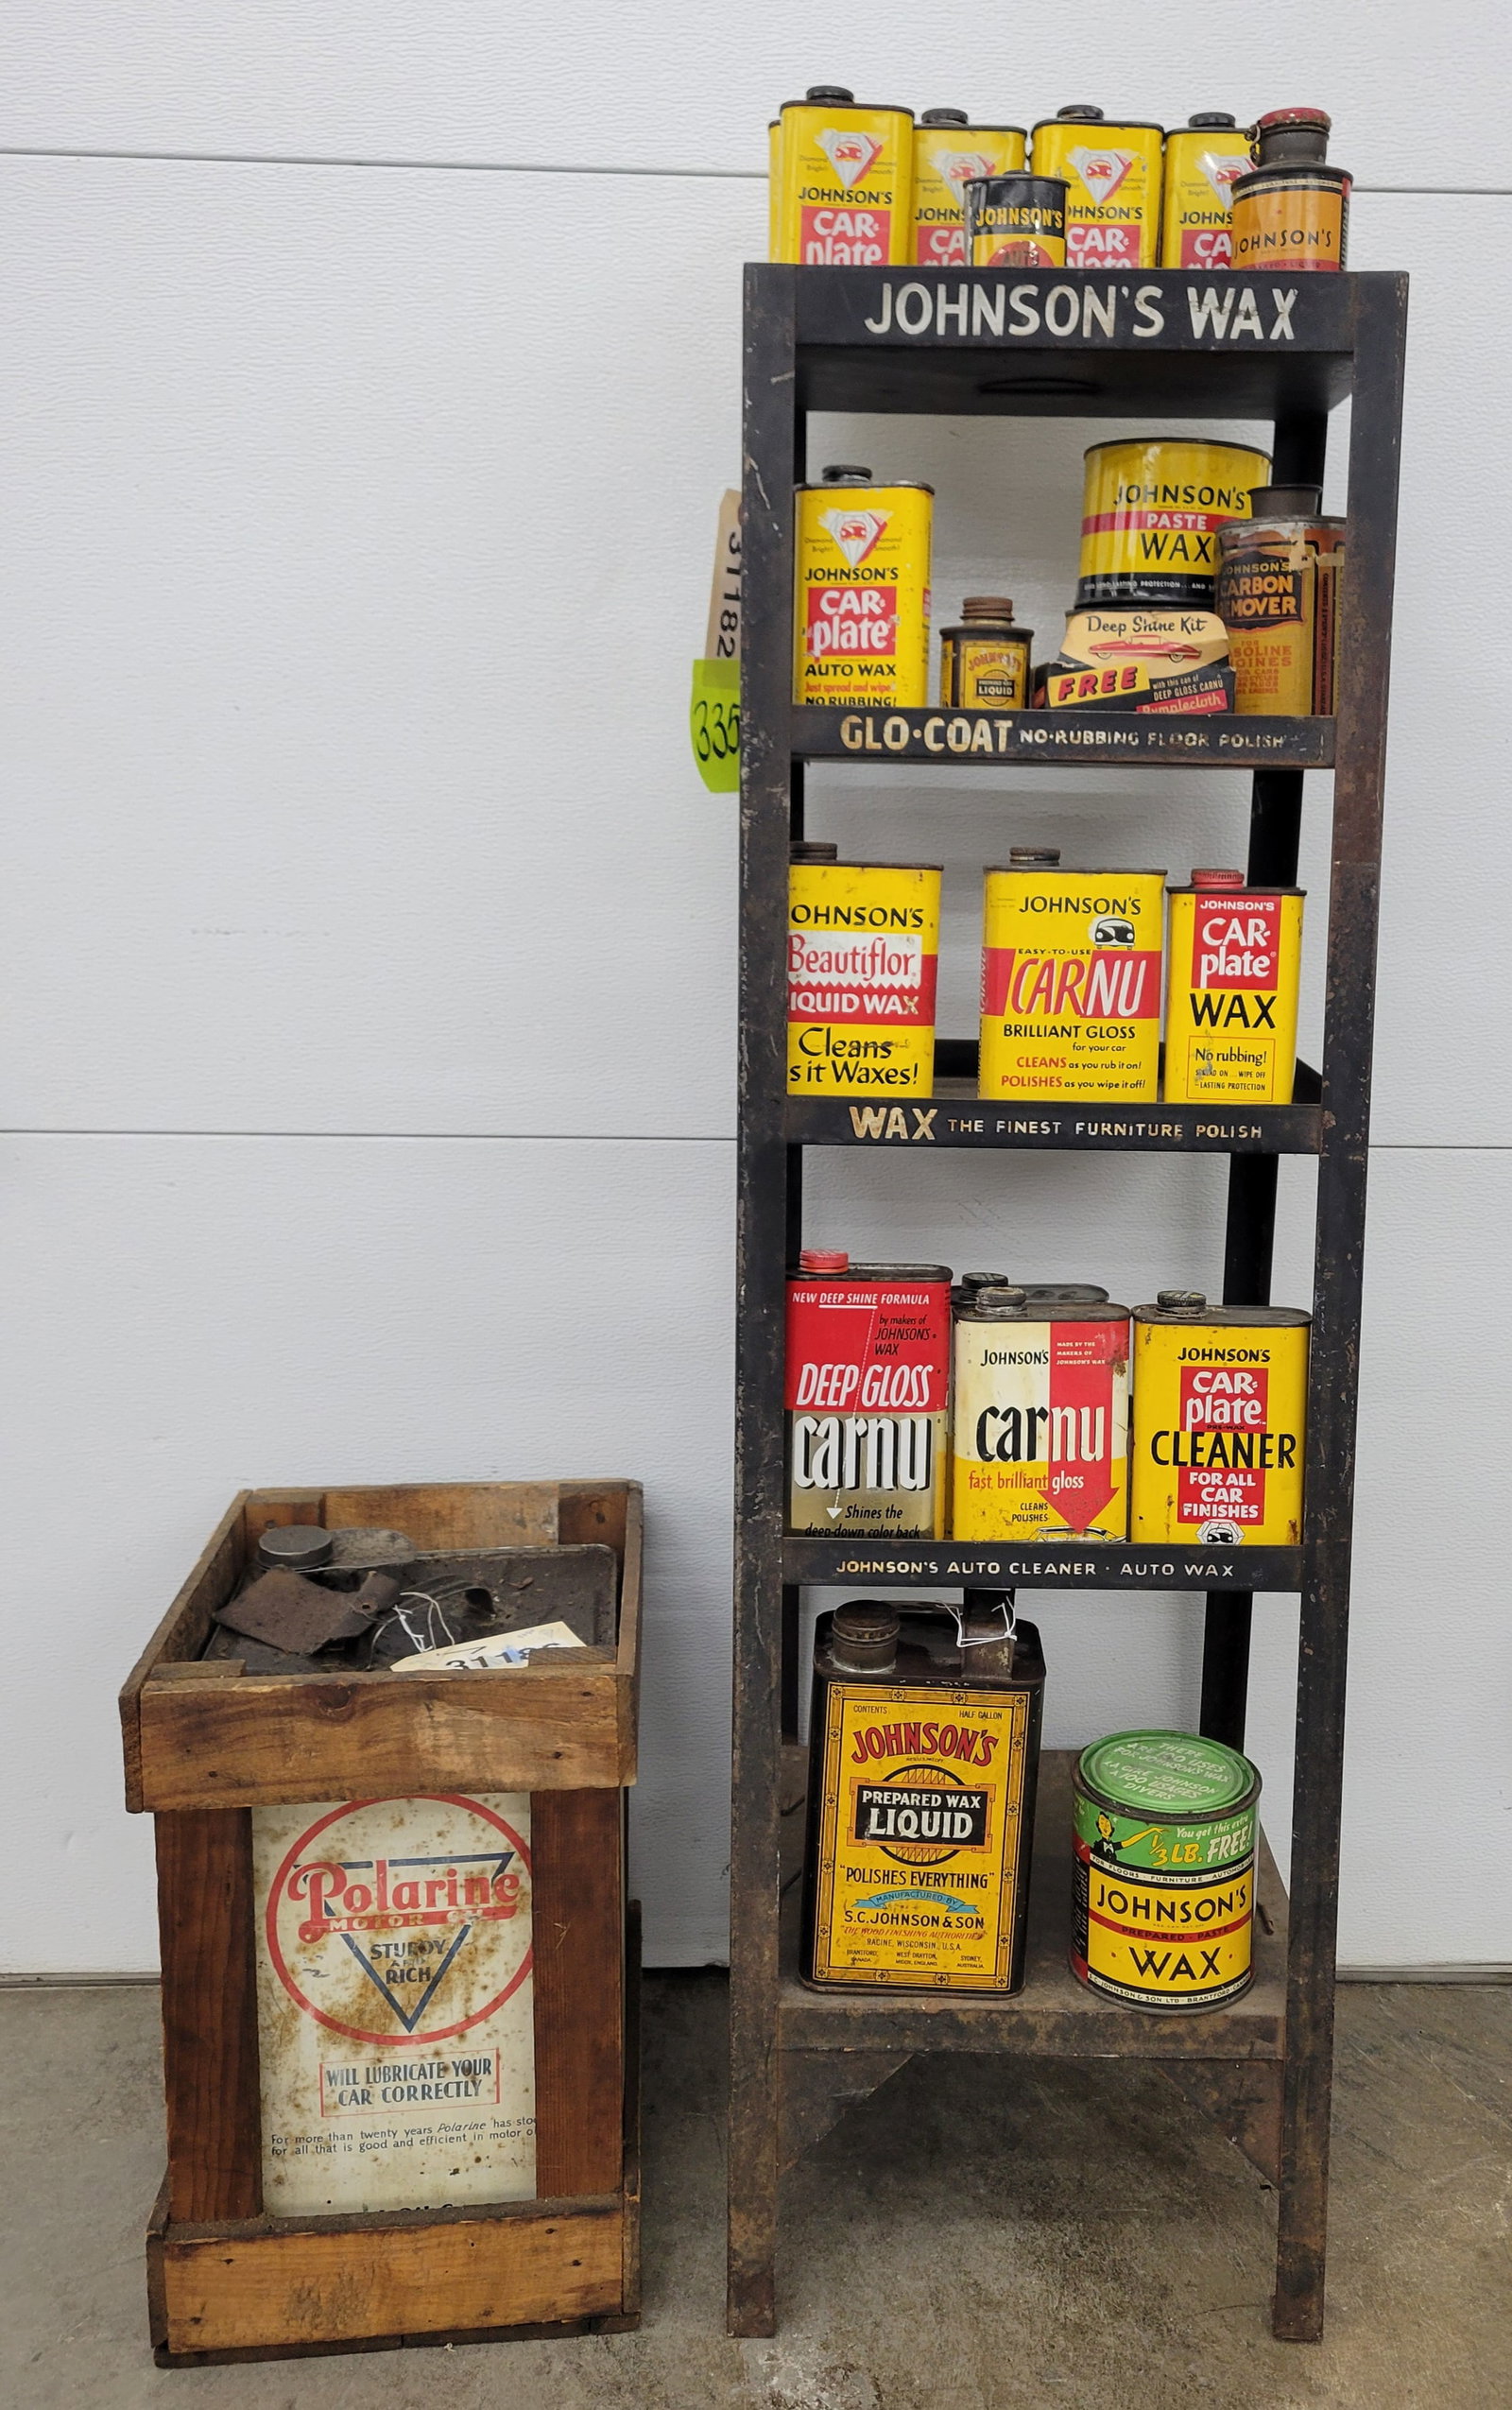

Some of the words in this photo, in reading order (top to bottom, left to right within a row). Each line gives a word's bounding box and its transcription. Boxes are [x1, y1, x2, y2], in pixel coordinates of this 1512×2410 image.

[799, 187, 892, 204] JOHNSON'S
[976, 208, 1063, 229] JOHNSON'S
[1069, 206, 1143, 219] HNSON'S
[1179, 212, 1232, 224] JOHNS
[1234, 229, 1331, 259] JOHNSON'S
[864, 284, 1163, 339] JOHNSON'S
[1188, 286, 1297, 341] WAX
[1113, 485, 1246, 510] JOHNSON'S
[1147, 513, 1208, 530] PASTE
[1141, 533, 1211, 563] WAX
[805, 567, 899, 581] JOHNSON'S
[815, 616, 889, 656] plate
[1088, 616, 1127, 637] Deep
[1181, 616, 1208, 635] Kit
[805, 664, 853, 676] AUTO
[858, 664, 896, 676] WAX
[979, 686, 1012, 695] LIQUID
[1058, 666, 1137, 701] FREE
[1154, 689, 1172, 701] DEEP
[1175, 684, 1197, 697] GLOSS
[829, 697, 897, 707] RUBBING!
[1147, 732, 1210, 749] FLOOR
[1019, 896, 1141, 915] JOHNSON'S
[1200, 901, 1275, 911] JOHNSON'S
[791, 904, 923, 927] OHNSON'S
[788, 934, 917, 980] Beautiflor
[1201, 946, 1270, 989] plate
[1011, 957, 1146, 1016] CARNU
[789, 991, 860, 1013] IQUID
[864, 995, 919, 1014] WAX
[1190, 993, 1277, 1029] WAX
[1004, 1024, 1081, 1038] BRILLIANT
[1086, 1026, 1135, 1038] GLOSS
[799, 1027, 892, 1059] Cleans
[1073, 1042, 1086, 1051] for
[1089, 1044, 1109, 1053] your
[1017, 1057, 1067, 1068] CLEANS
[1082, 1061, 1099, 1070] you
[1101, 1059, 1116, 1069] rub
[1119, 1060, 1125, 1069] it
[1195, 1048, 1213, 1060] No
[1217, 1046, 1266, 1066] rubbing!
[807, 1061, 826, 1082] it
[832, 1060, 918, 1084] Waxes!
[1002, 1076, 1062, 1087] POLISHES
[1078, 1080, 1094, 1089] you
[1097, 1080, 1119, 1090] wipe
[1122, 1079, 1128, 1088] it
[849, 1106, 938, 1141] WAX
[947, 1119, 984, 1133] THE
[996, 1120, 1060, 1134] FINEST
[1075, 1121, 1183, 1137] FURNITURE
[1195, 1124, 1263, 1139] POLISH
[793, 1292, 816, 1303] NEW
[819, 1293, 845, 1303] DEEP
[847, 1293, 877, 1304] SHINE
[881, 1294, 929, 1304] FORMULA
[880, 1315, 887, 1324] by
[890, 1315, 916, 1324] makers
[919, 1315, 927, 1324] of
[875, 1344, 899, 1355] WAX
[1177, 1348, 1270, 1362] JOHNSON'S
[797, 1363, 859, 1406] DEEP
[861, 1365, 934, 1407] GLOSS
[1186, 1395, 1262, 1431] plate
[976, 1405, 1105, 1462] carnu
[794, 1416, 933, 1490] carnu
[1151, 1431, 1297, 1469] CLEANER
[969, 1471, 991, 1490] fast
[998, 1471, 1048, 1489] brilliant
[1052, 1471, 1084, 1494] gloss
[1190, 1472, 1222, 1486] FOR
[1227, 1473, 1256, 1486] ALL
[1201, 1488, 1243, 1503] CAR
[845, 1504, 881, 1519] Shines
[885, 1504, 902, 1519] the
[1021, 1503, 1048, 1511] CLEANS
[1183, 1504, 1259, 1519] FINISHES
[1012, 1513, 1048, 1523] POLISHES
[867, 1524, 896, 1539] color
[897, 1525, 920, 1539] back
[836, 1560, 938, 1575] JOHNSON'S
[947, 1562, 1000, 1575] AUTO
[1009, 1562, 1096, 1575] CLEANER
[1120, 1563, 1174, 1575] AUTO
[1185, 1564, 1234, 1577] WAX
[853, 1705, 887, 1714] CONTENTS
[978, 1711, 1002, 1720] GALLON
[851, 1722, 999, 1766] JOHNSON'S
[1155, 1775, 1218, 1794] JOHNSON
[862, 1790, 941, 1807] PREPARED
[946, 1795, 982, 1809] WAX
[869, 1808, 973, 1839] LIQUID
[1177, 1827, 1194, 1838] You
[1195, 1827, 1211, 1840] get
[1214, 1821, 1229, 1834] this
[1231, 1816, 1249, 1829] extra
[1171, 1844, 1203, 1863] LB.
[1208, 1821, 1253, 1863] FREE!
[1108, 1864, 1139, 1878] FLOORS
[287, 1860, 520, 1923] Polarine
[876, 1891, 942, 1902] MANUFACTURED
[946, 1897, 958, 1906] BY
[1097, 1885, 1246, 1923] JOHNSON'S
[942, 1917, 953, 1928] &
[954, 1918, 984, 1929] SON
[1122, 1926, 1184, 1941] PREPARED
[1197, 1927, 1228, 1939] PASTE
[370, 1939, 446, 1960] STURDY
[1128, 1946, 1221, 1981] WAX
[386, 1967, 431, 1985] RICH
[1187, 1988, 1229, 2003] BRANTFORD
[326, 2068, 359, 2087] WILL
[366, 2062, 444, 2085] LUBRICATE
[452, 2058, 491, 2077] YOUR
[338, 2089, 371, 2107] CAR
[382, 2079, 482, 2103] CORRECTLY
[271, 2134, 289, 2144] For
[295, 2134, 323, 2143] more
[329, 2132, 352, 2142] than
[360, 2128, 397, 2140] twenty
[404, 2126, 433, 2138] years
[493, 2119, 512, 2127] has
[271, 2145, 287, 2155] for
[295, 2144, 308, 2155] all
[315, 2143, 336, 2153] that
[343, 2142, 352, 2152] is
[359, 2140, 387, 2153] good
[393, 2137, 414, 2147] and
[420, 2133, 467, 2145] efficient
[473, 2132, 483, 2141] in
[490, 2128, 521, 2139] motor
